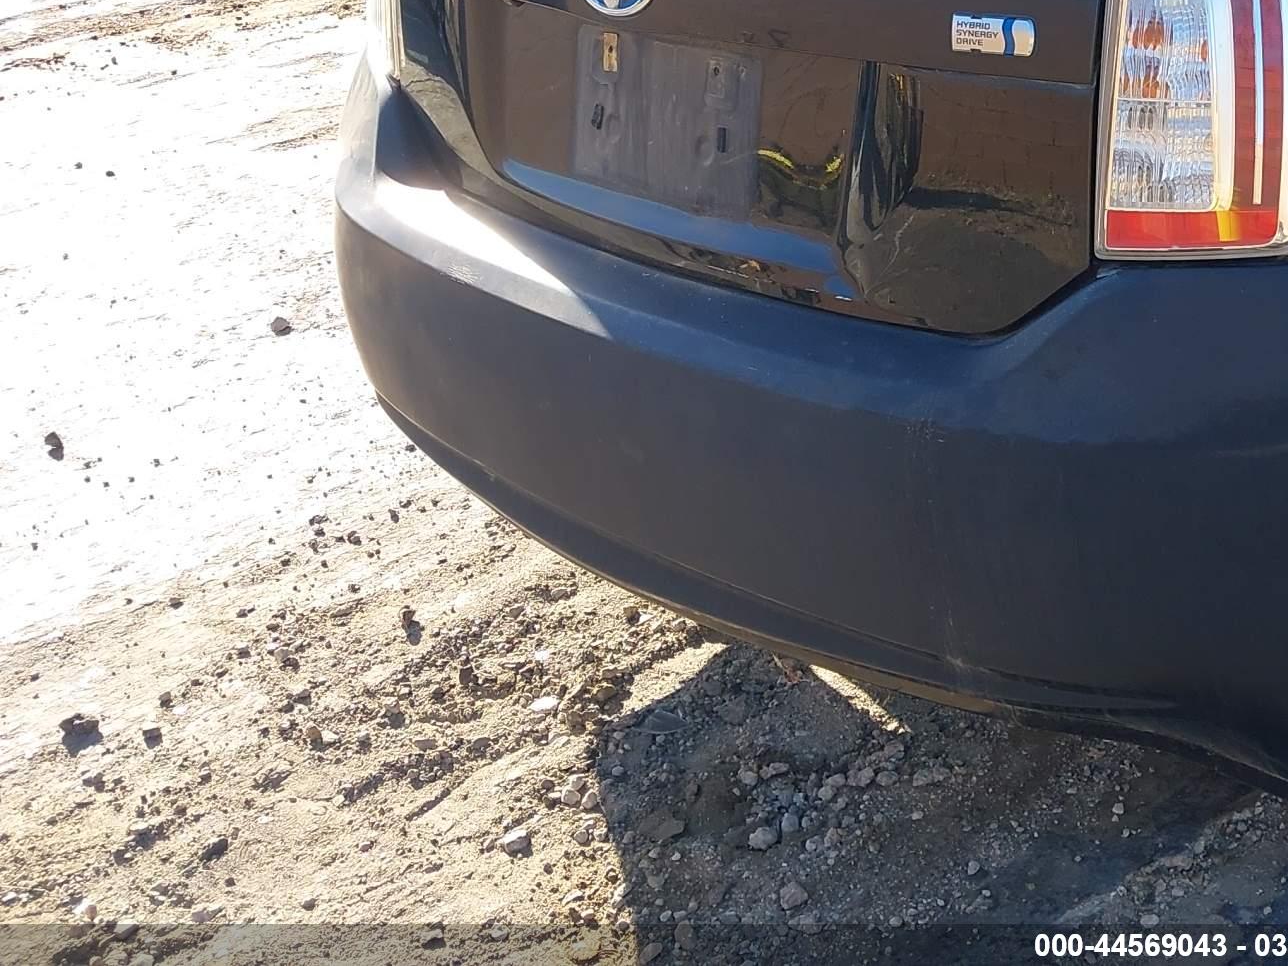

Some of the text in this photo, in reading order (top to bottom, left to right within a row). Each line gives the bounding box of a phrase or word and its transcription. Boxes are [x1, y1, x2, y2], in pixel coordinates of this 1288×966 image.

[956, 20, 991, 30] HYBRID
[956, 30, 999, 39] SYNERGY
[956, 37, 983, 47] DRIVE
